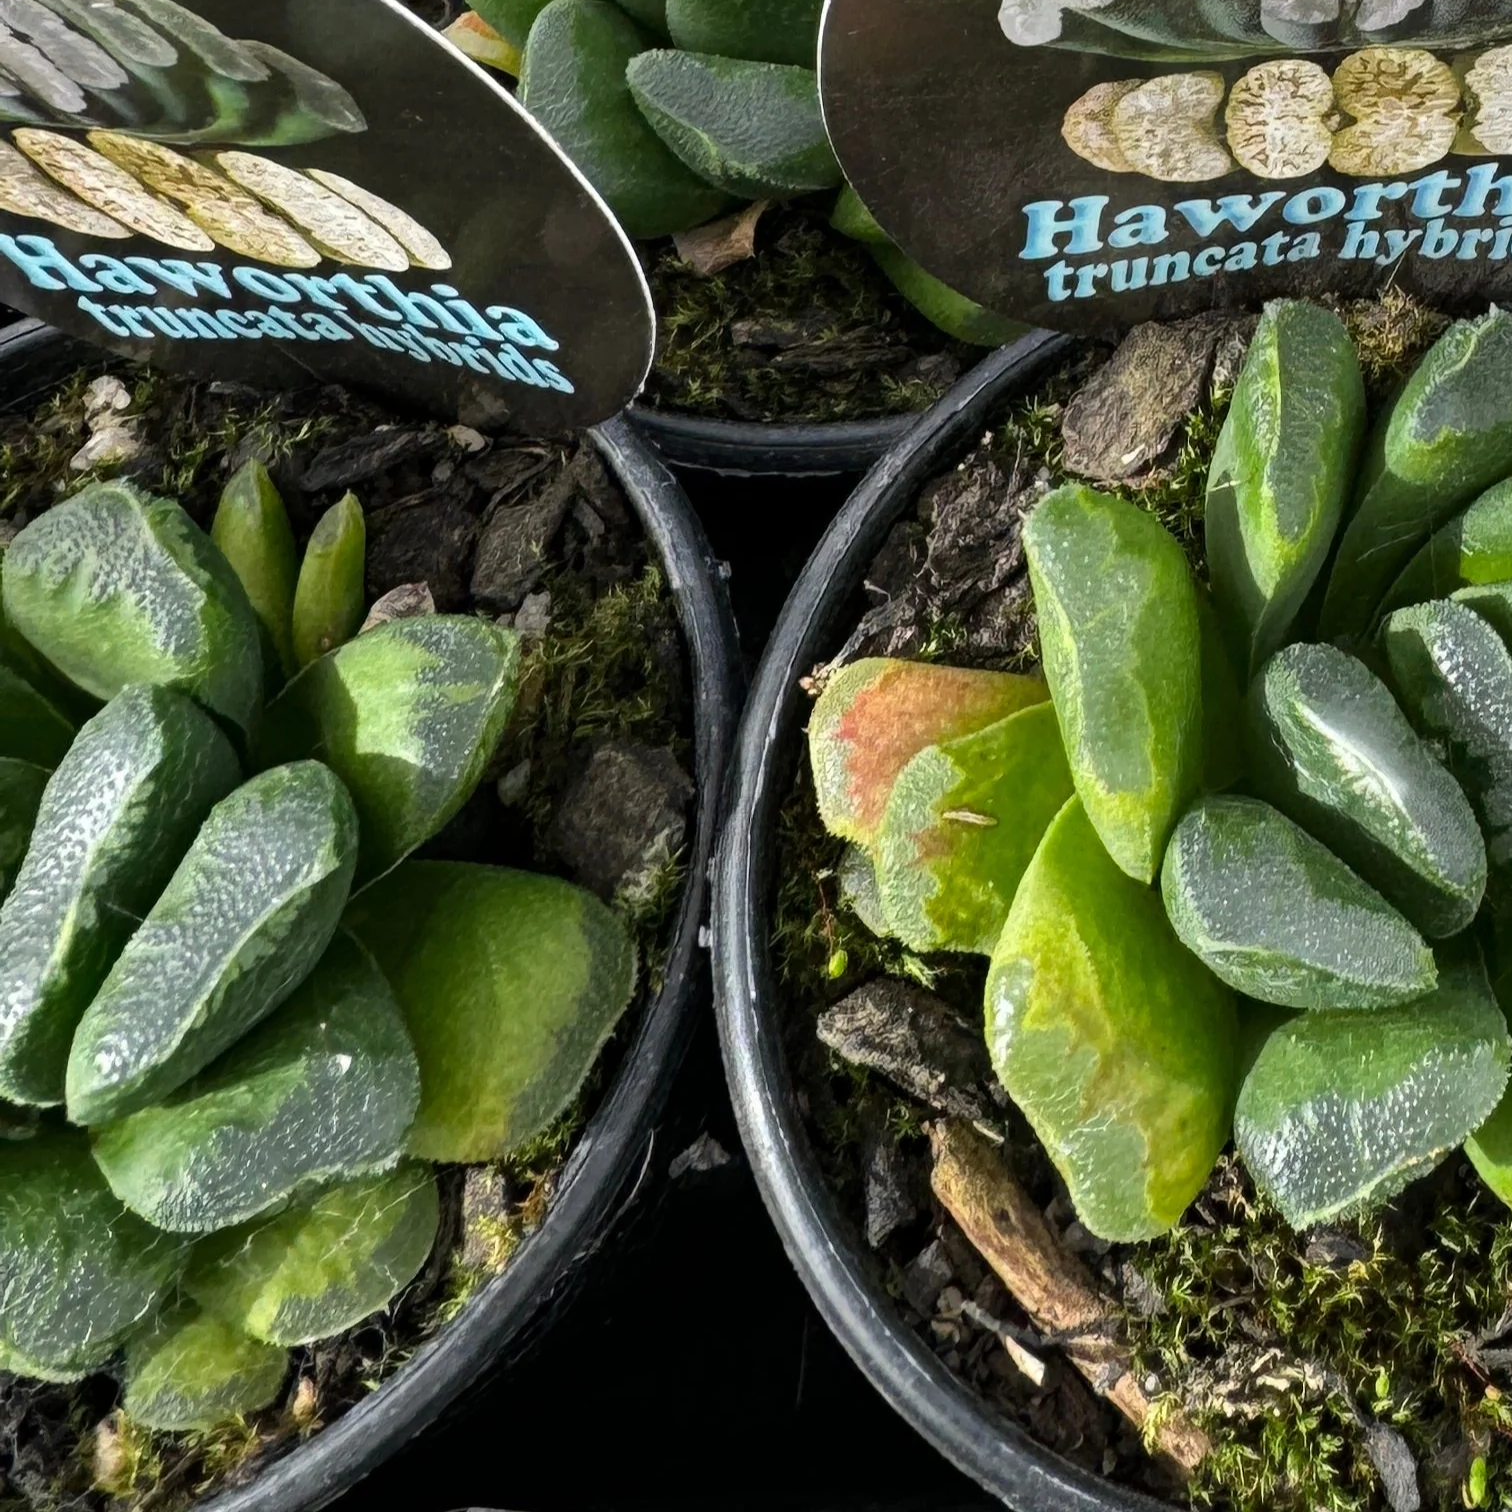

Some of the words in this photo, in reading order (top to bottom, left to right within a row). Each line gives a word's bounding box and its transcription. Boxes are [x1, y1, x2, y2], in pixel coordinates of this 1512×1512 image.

[0, 232, 560, 351] Haworthia
[1044, 225, 1321, 302] truncata
[77, 294, 355, 341] truncata
[333, 310, 575, 394] hybrids
